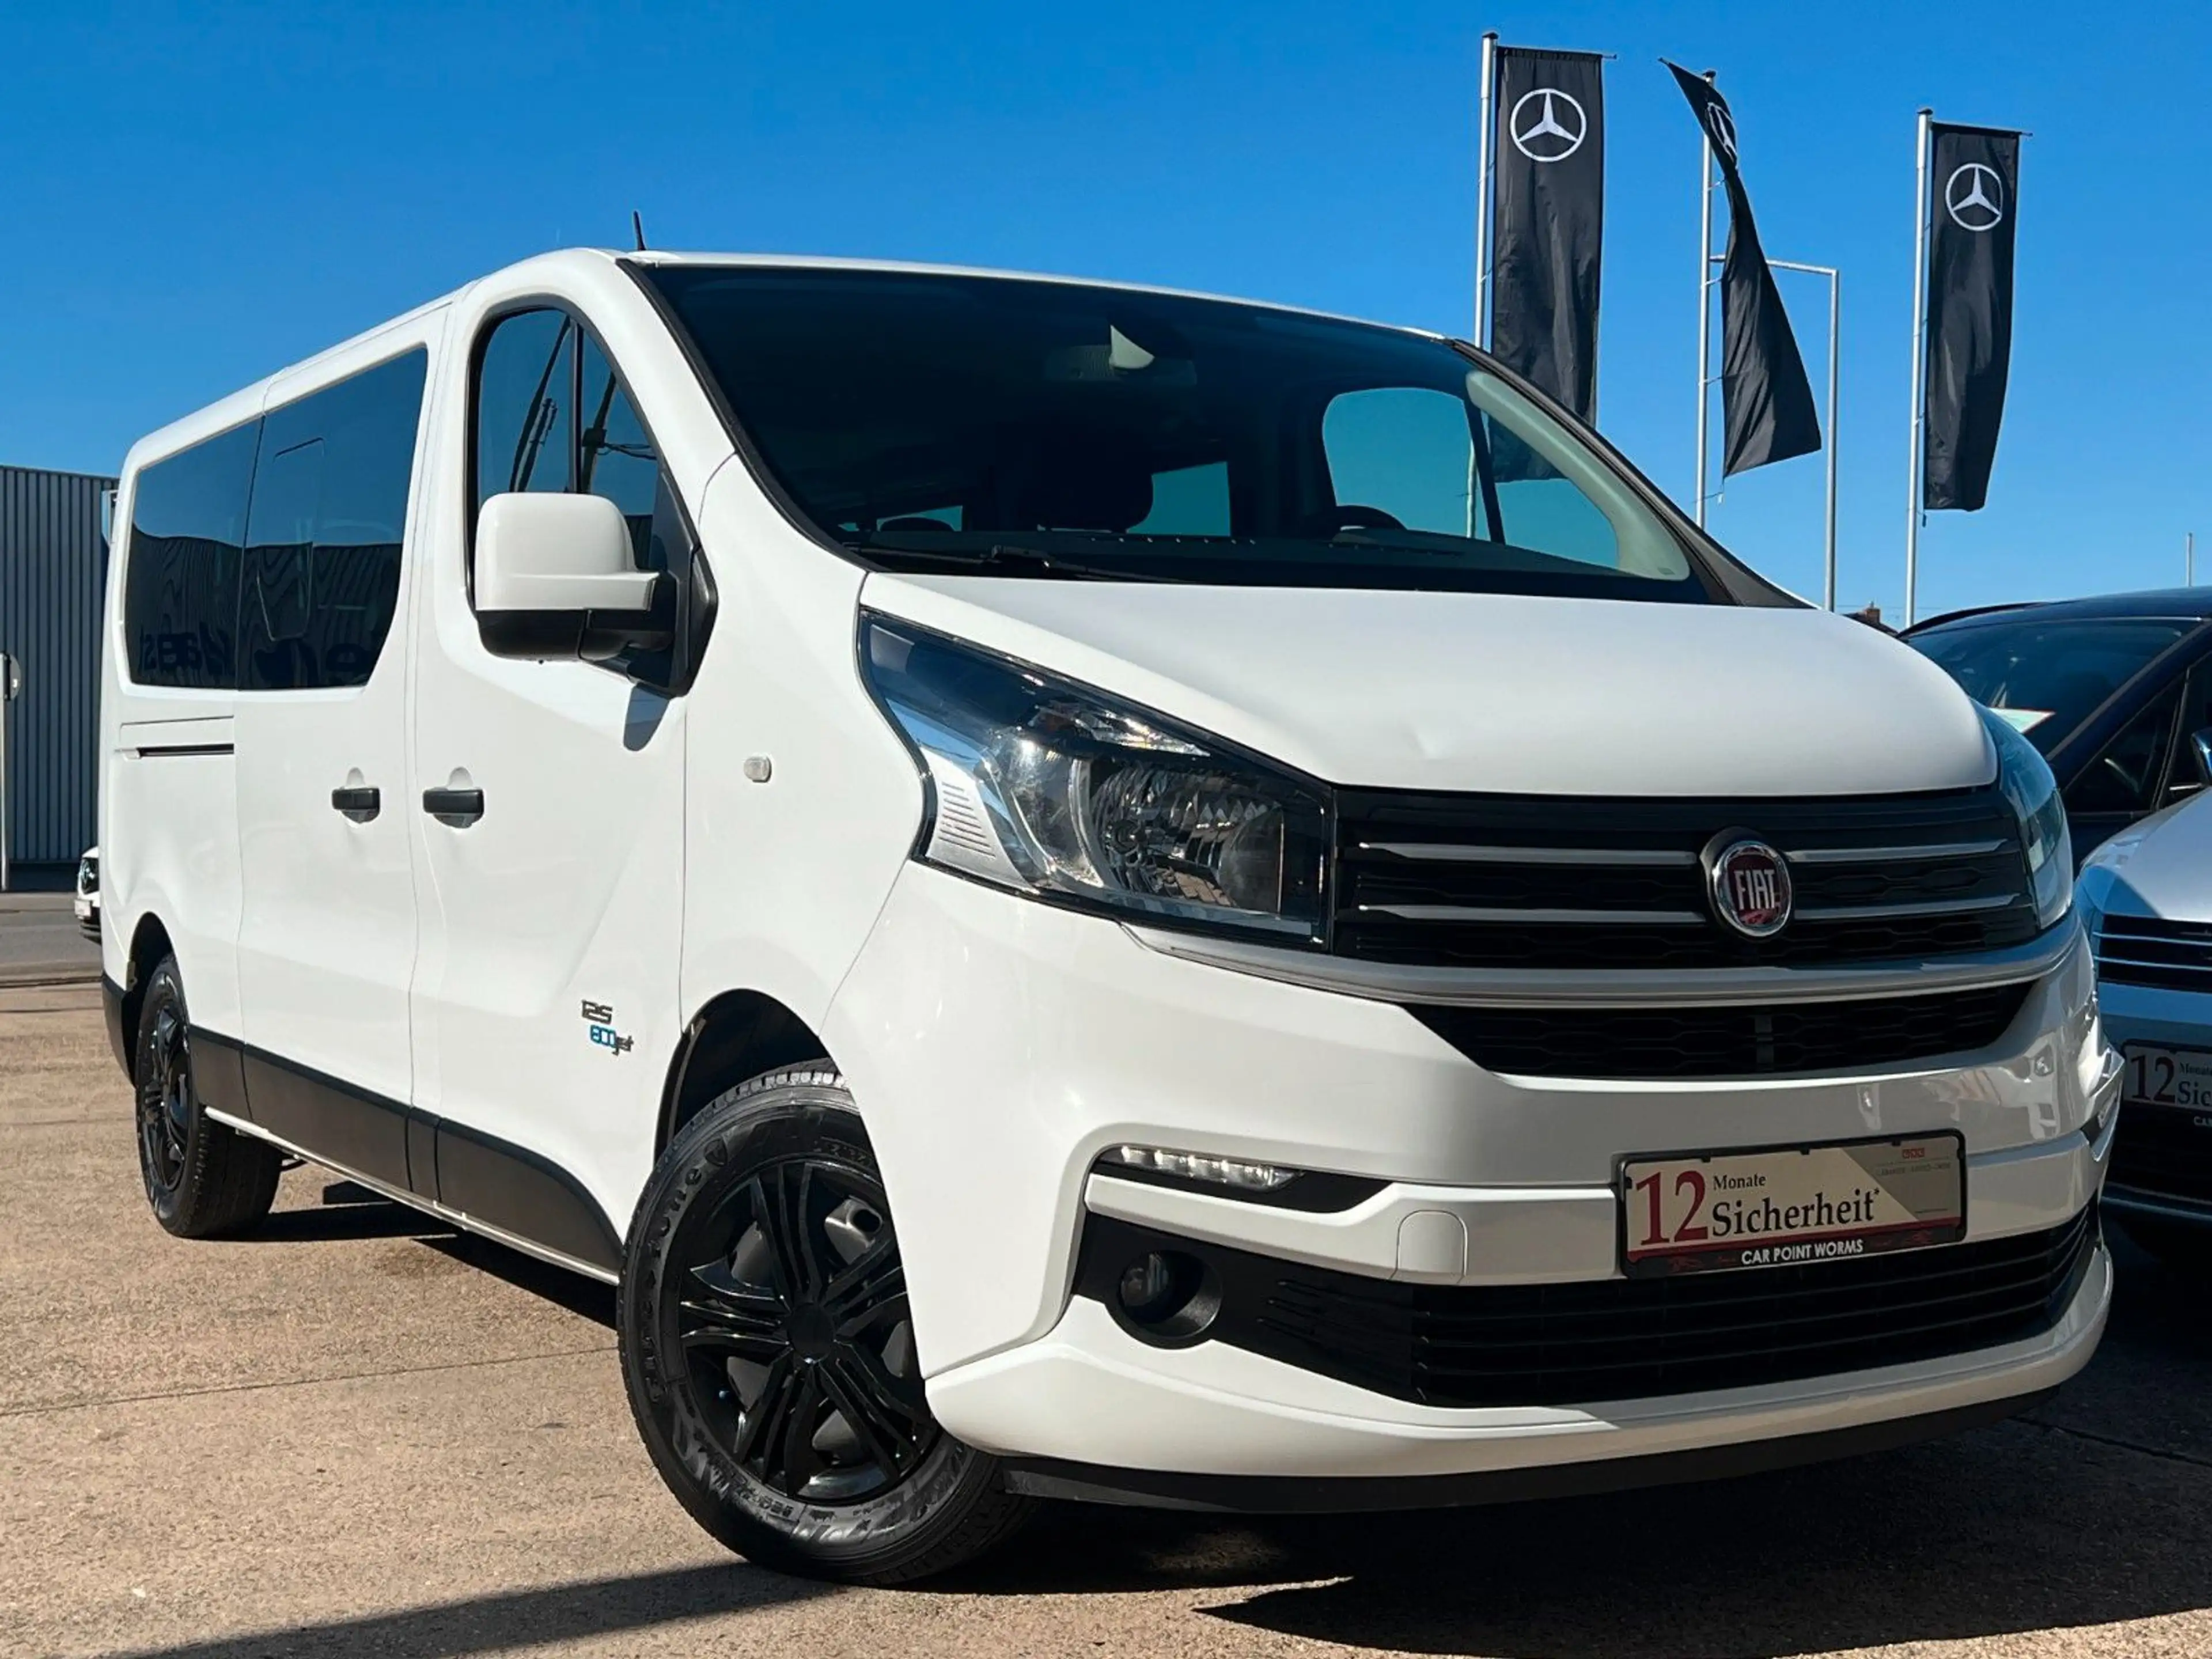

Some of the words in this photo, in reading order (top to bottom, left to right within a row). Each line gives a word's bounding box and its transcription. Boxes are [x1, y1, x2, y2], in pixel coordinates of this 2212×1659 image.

[1734, 869, 1775, 910] FIAT
[581, 999, 613, 1025] 125
[2131, 1055, 2175, 1103] 12
[1713, 1172, 1766, 1191] Monate
[1635, 1170, 1709, 1245] 12
[1741, 1248, 1770, 1265] CAR
[1773, 1243, 1813, 1262] POINT
[1814, 1238, 1864, 1257] WORMS
